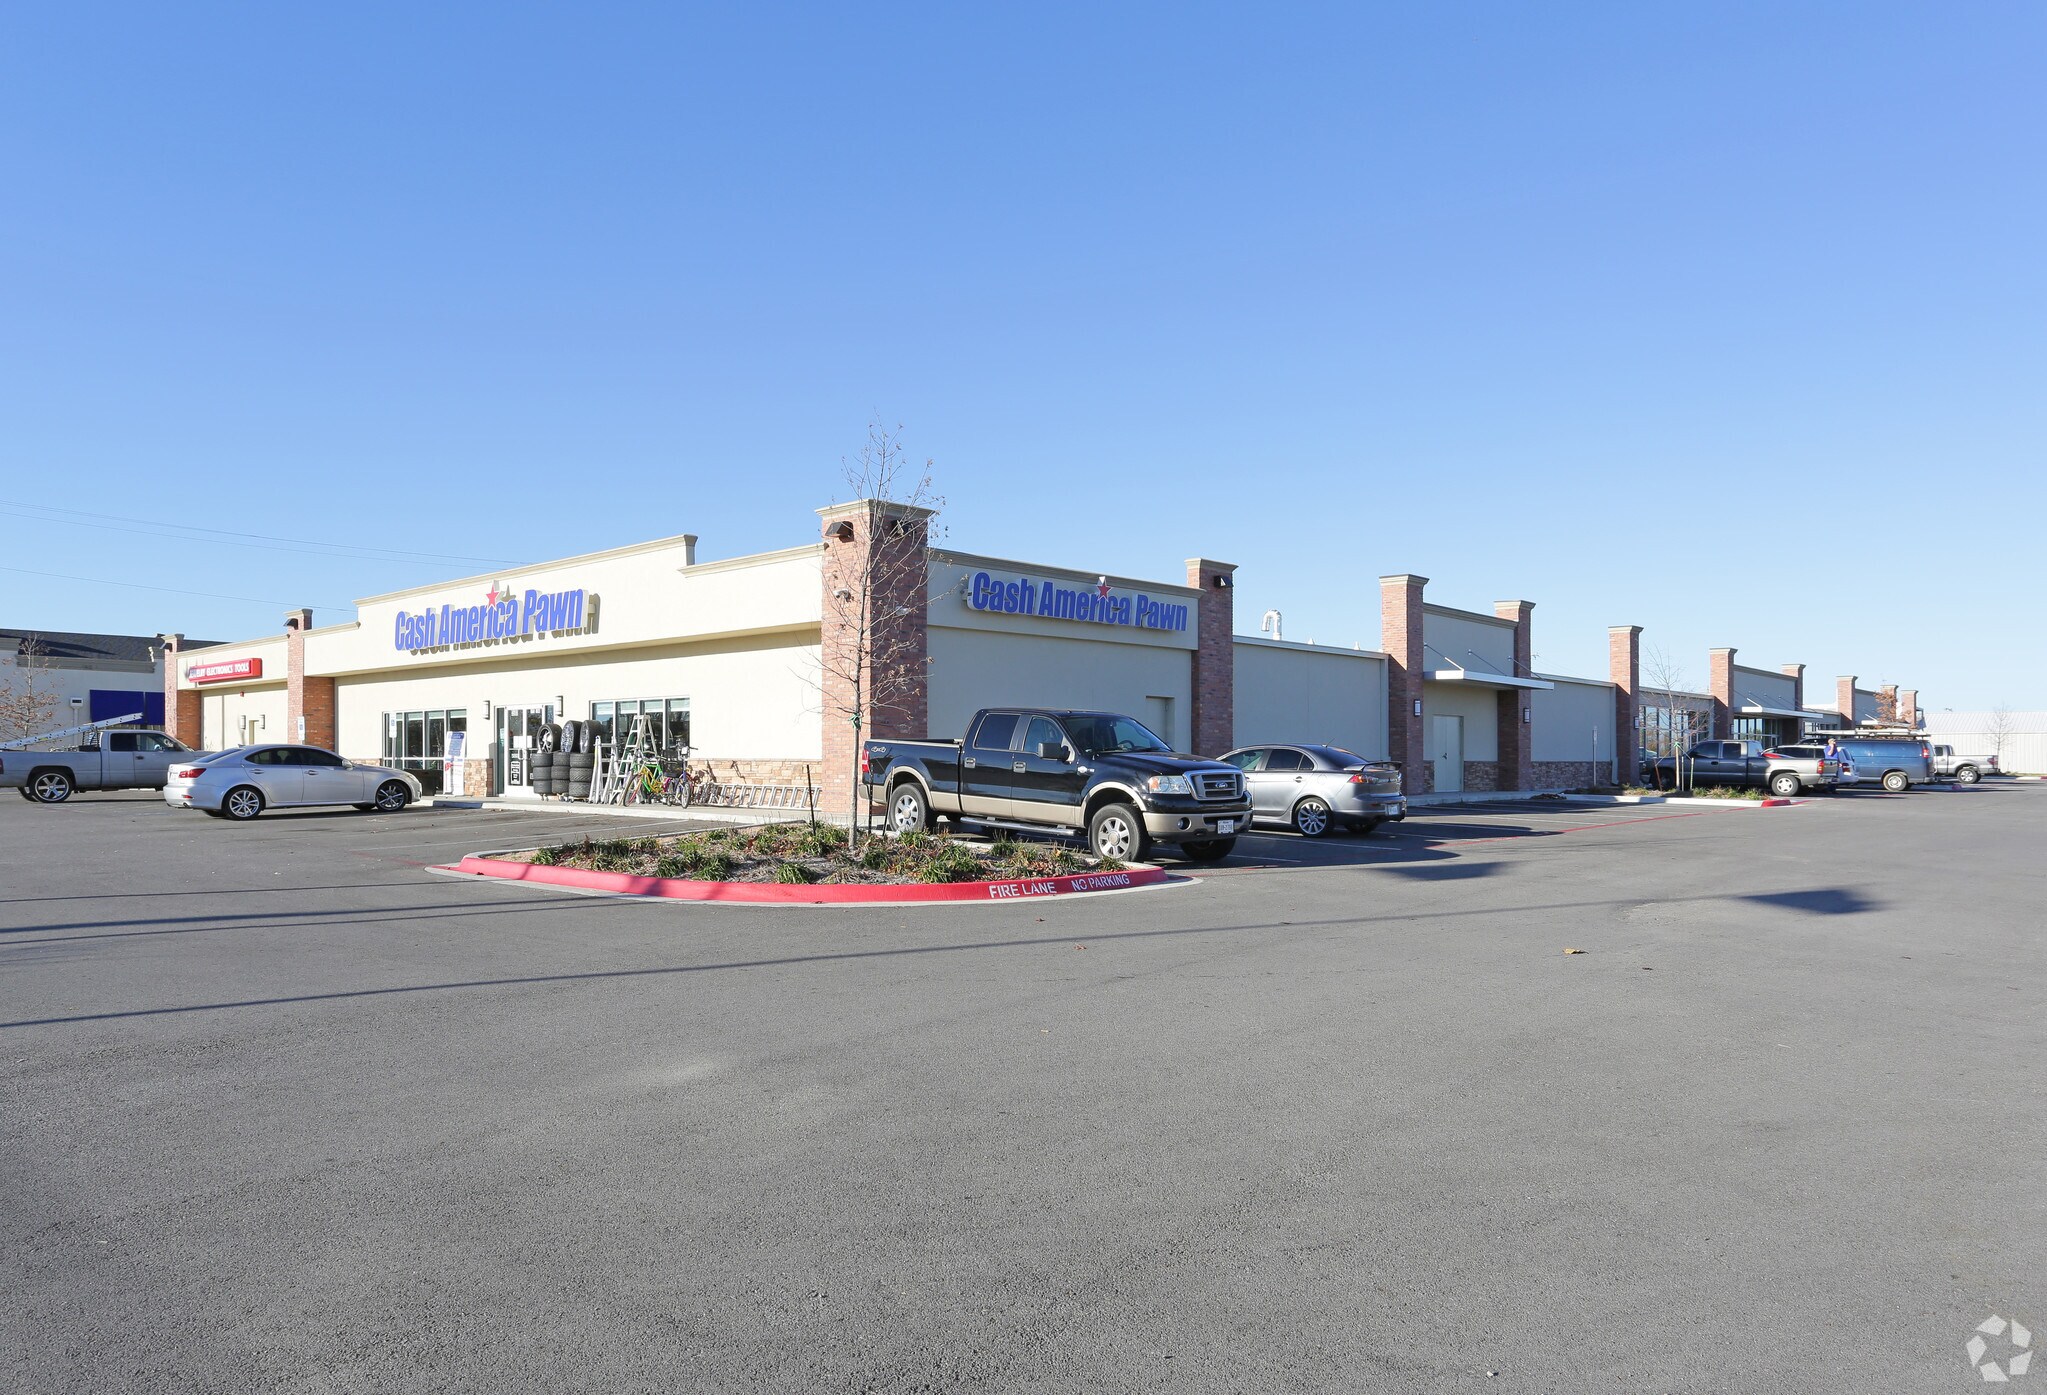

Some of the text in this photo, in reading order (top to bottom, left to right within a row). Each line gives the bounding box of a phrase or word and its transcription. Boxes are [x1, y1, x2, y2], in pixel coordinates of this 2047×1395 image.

[395, 588, 584, 651] Cash America Pawn
[972, 571, 1188, 632] Cash America Pawn
[206, 665, 233, 676] ELECTRONICS
[235, 662, 249, 672] TOOLS
[989, 874, 1130, 898] FIRE LANE NO PARKING
